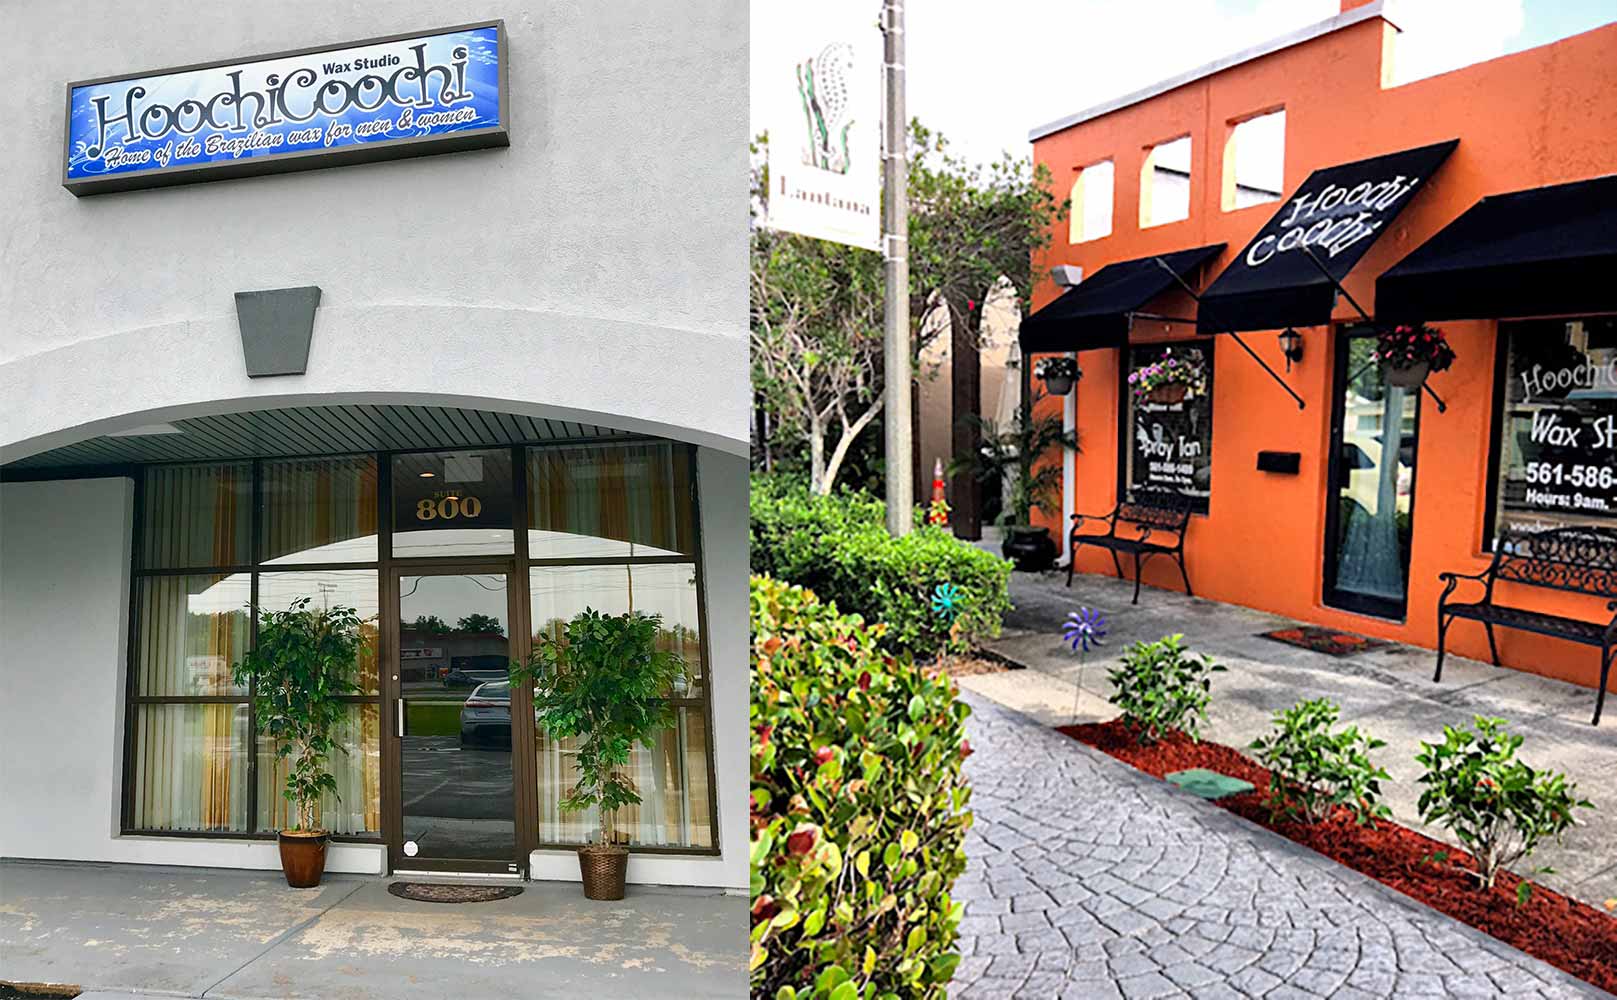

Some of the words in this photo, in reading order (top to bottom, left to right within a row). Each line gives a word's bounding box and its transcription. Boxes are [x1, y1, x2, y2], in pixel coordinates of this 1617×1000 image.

[323, 62, 352, 76] Wax
[354, 54, 401, 70] Studio
[87, 43, 472, 158] HoochiCoochi
[105, 147, 150, 167] Home
[154, 141, 172, 167] of
[176, 138, 201, 158] the
[206, 131, 282, 157] Brazilian
[287, 127, 322, 146] wax
[324, 121, 352, 147] for
[356, 119, 391, 134] men
[398, 109, 413, 128] &
[418, 108, 477, 128] women
[1530, 411, 1581, 448] Wax
[1178, 435, 1201, 458] Tan
[415, 496, 482, 520] 800
[1525, 488, 1571, 507] Hours:
[1573, 492, 1610, 510] 9am.
